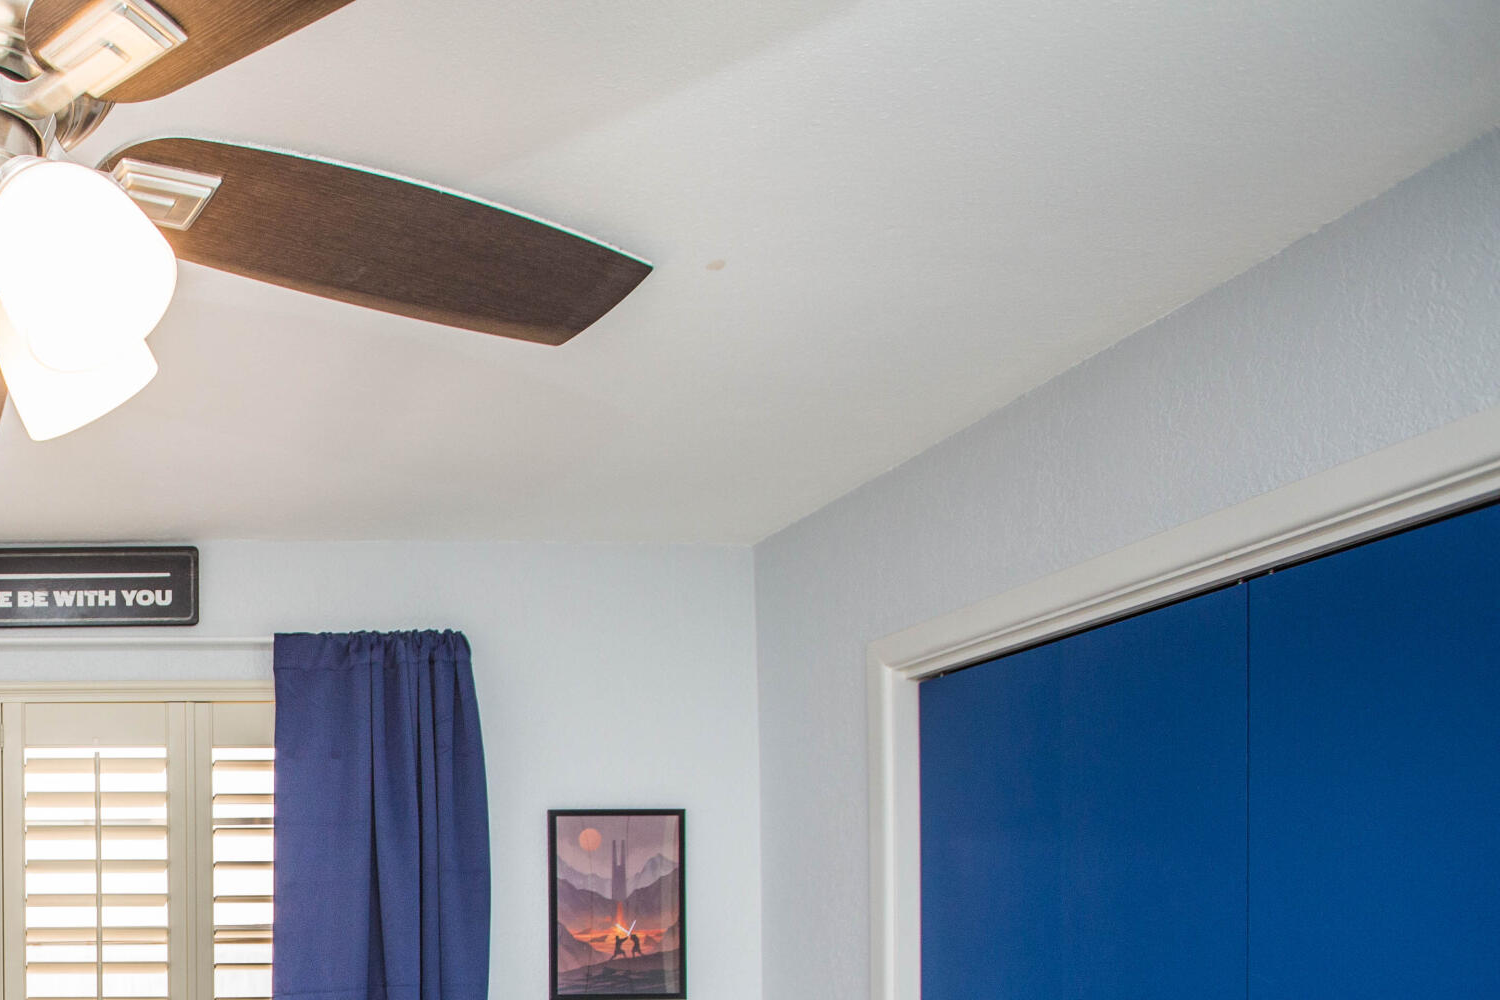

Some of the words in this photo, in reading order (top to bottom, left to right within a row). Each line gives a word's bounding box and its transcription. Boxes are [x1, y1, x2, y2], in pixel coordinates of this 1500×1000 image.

[17, 590, 49, 608] BE
[52, 590, 116, 607] WITH
[120, 589, 173, 606] YOU
